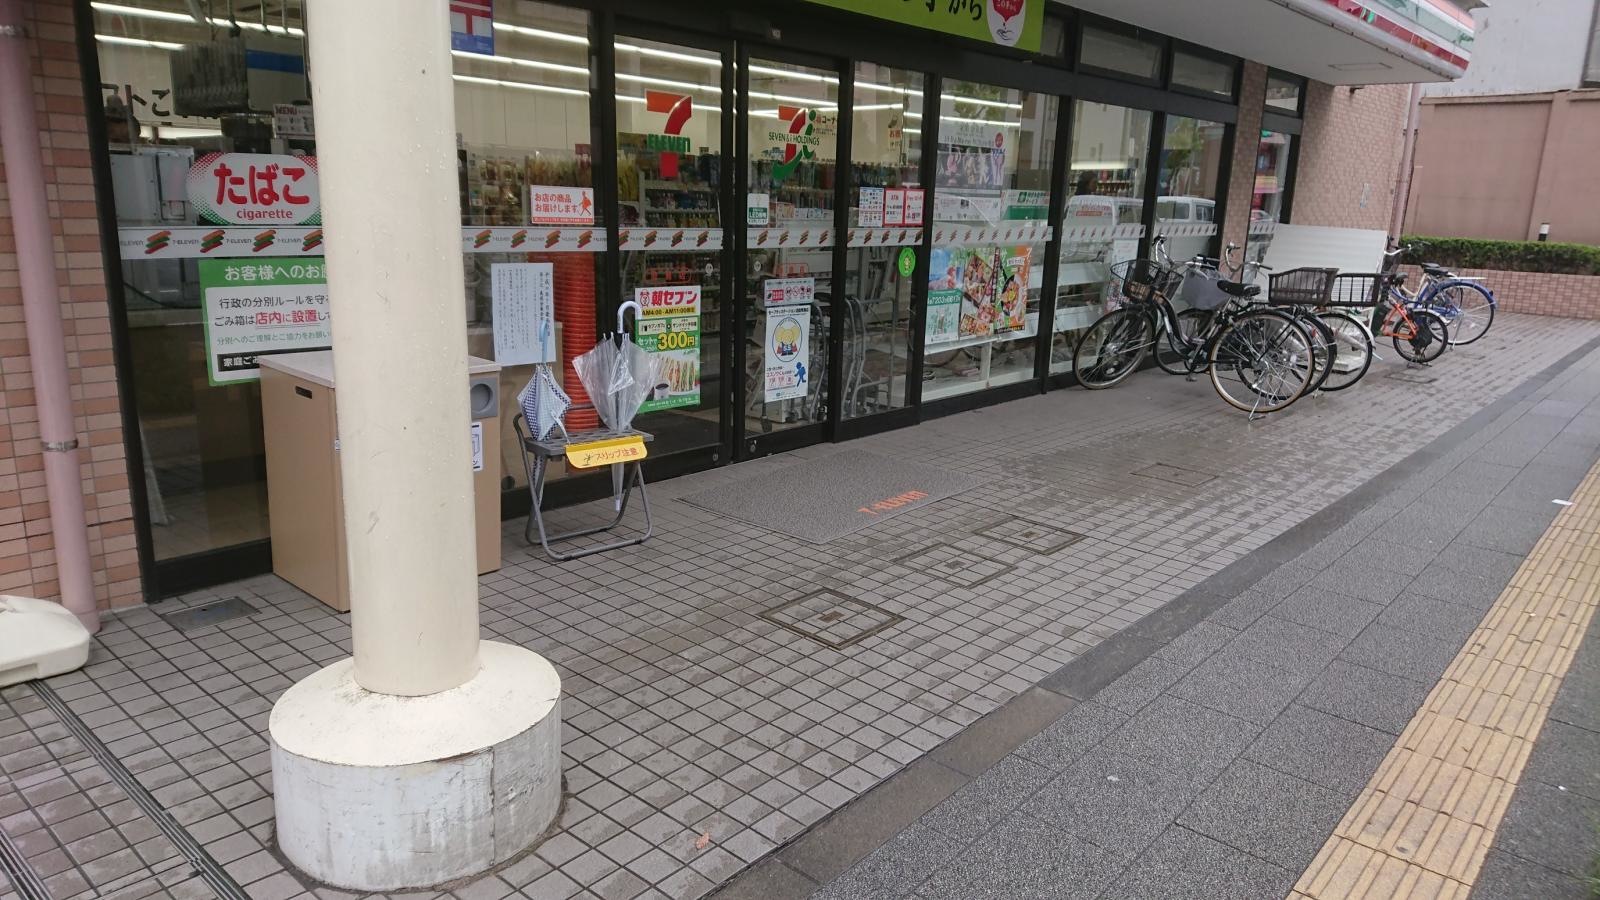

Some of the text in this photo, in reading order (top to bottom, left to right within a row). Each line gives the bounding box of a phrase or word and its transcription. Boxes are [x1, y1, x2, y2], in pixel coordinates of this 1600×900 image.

[793, 135, 820, 146] HOLDINGS
[213, 163, 310, 206] たばこ
[534, 192, 572, 203] お店の商品
[236, 208, 293, 221] cigarette
[534, 203, 578, 214] お届けします
[651, 290, 698, 306] 朝セブン
[657, 331, 695, 351] 300円
[596, 447, 639, 461] スリップ注意
